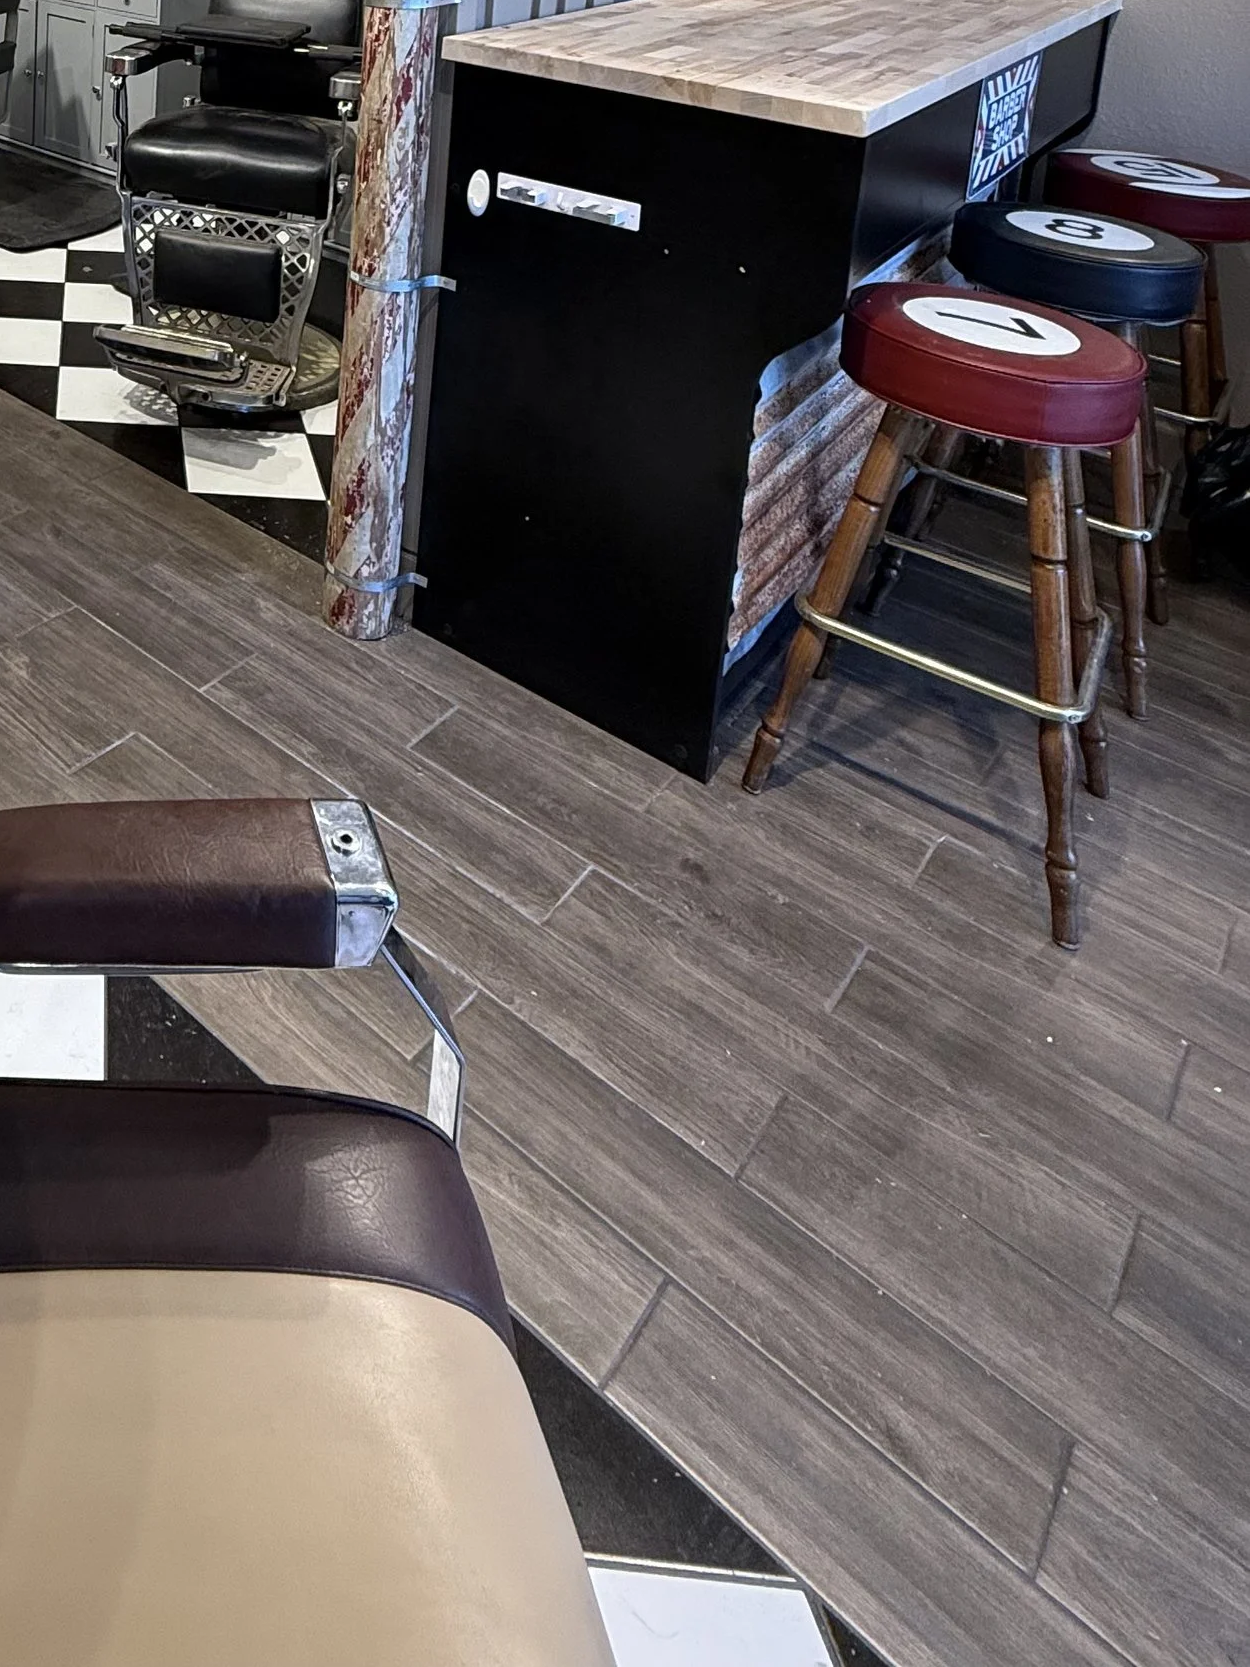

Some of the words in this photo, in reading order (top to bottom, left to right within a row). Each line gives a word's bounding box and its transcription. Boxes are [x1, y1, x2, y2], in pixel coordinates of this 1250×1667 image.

[988, 85, 1028, 130] BARBER
[991, 114, 1019, 151] SHOP
[1045, 217, 1106, 240] 8
[935, 310, 1047, 340] 1
